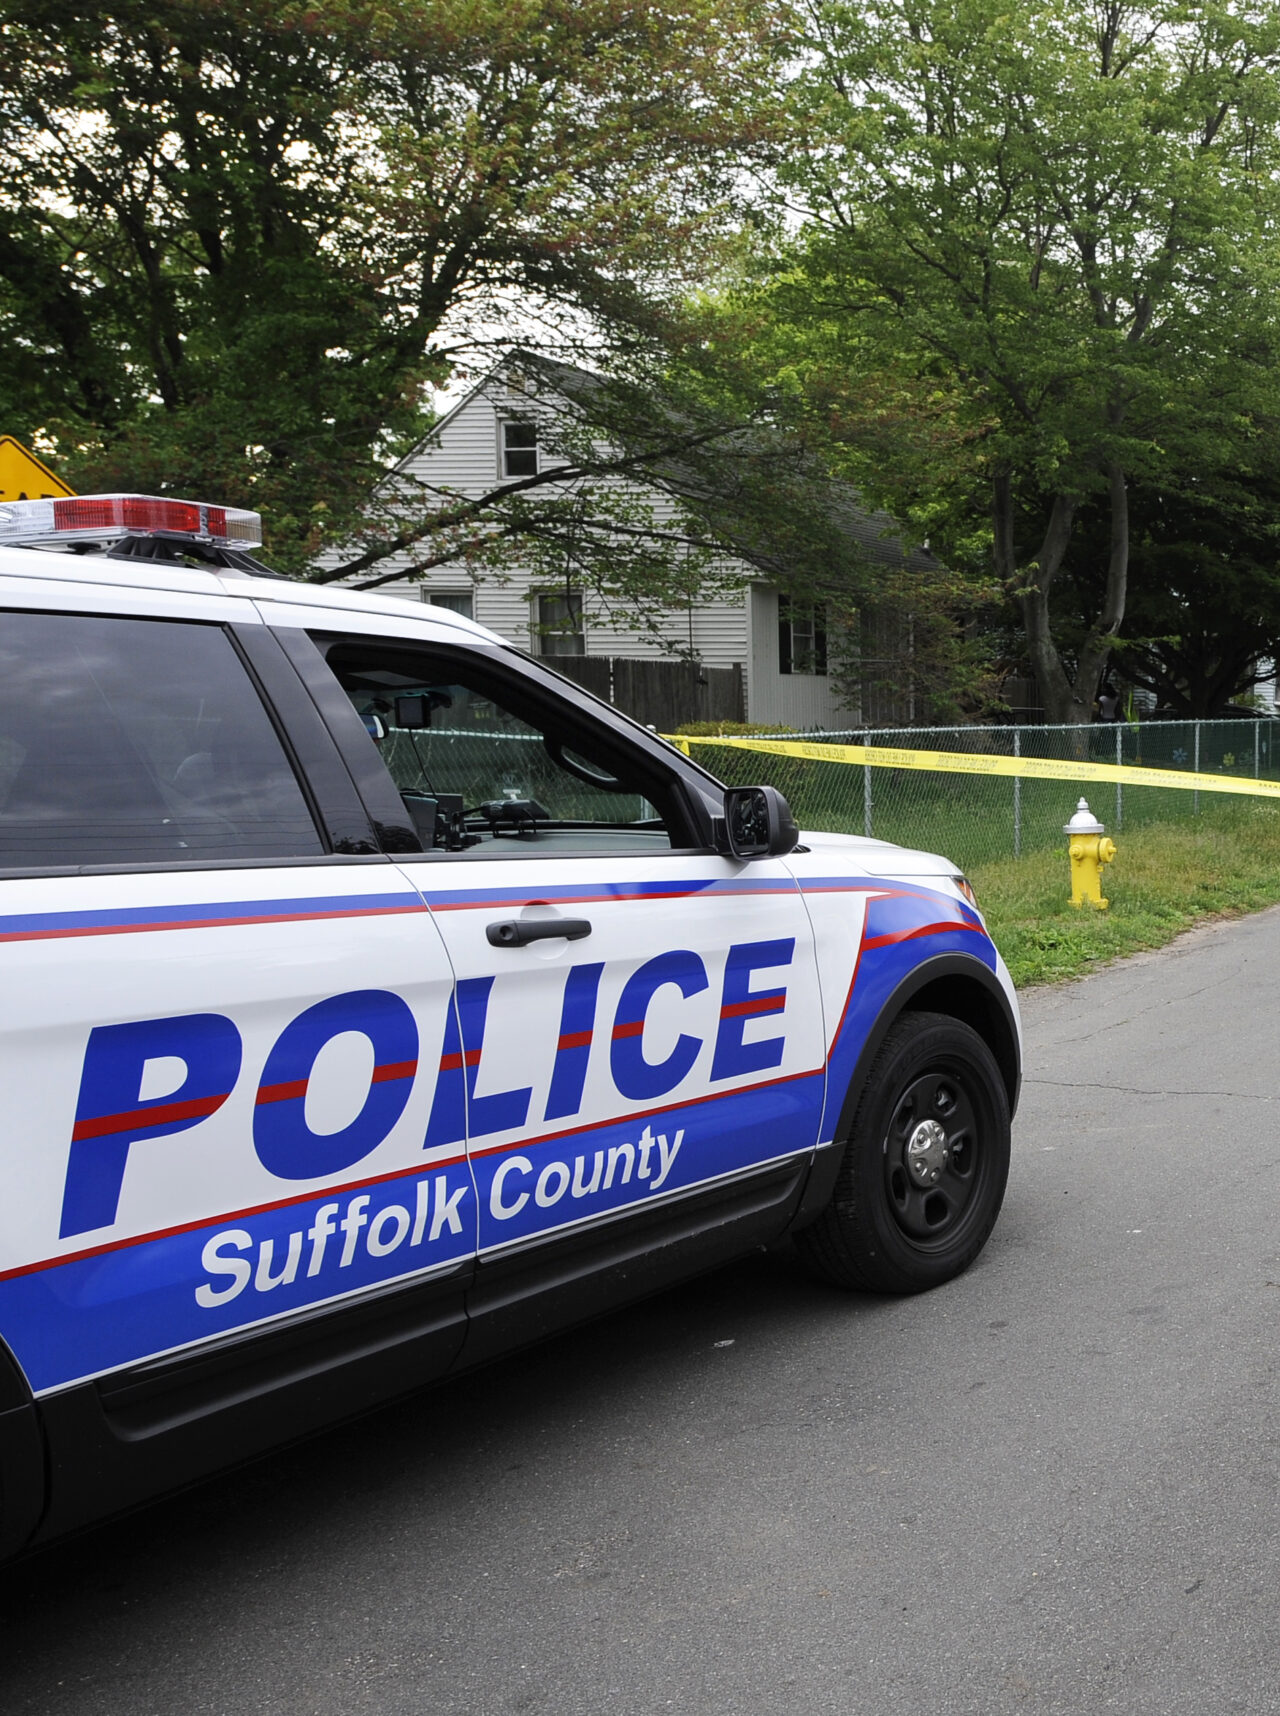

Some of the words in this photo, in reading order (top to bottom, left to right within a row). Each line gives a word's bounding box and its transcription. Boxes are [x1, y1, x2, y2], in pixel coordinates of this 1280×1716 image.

[59, 937, 796, 1240] POLICE
[195, 1175, 469, 1308] Suffolk
[490, 1126, 684, 1220] County
